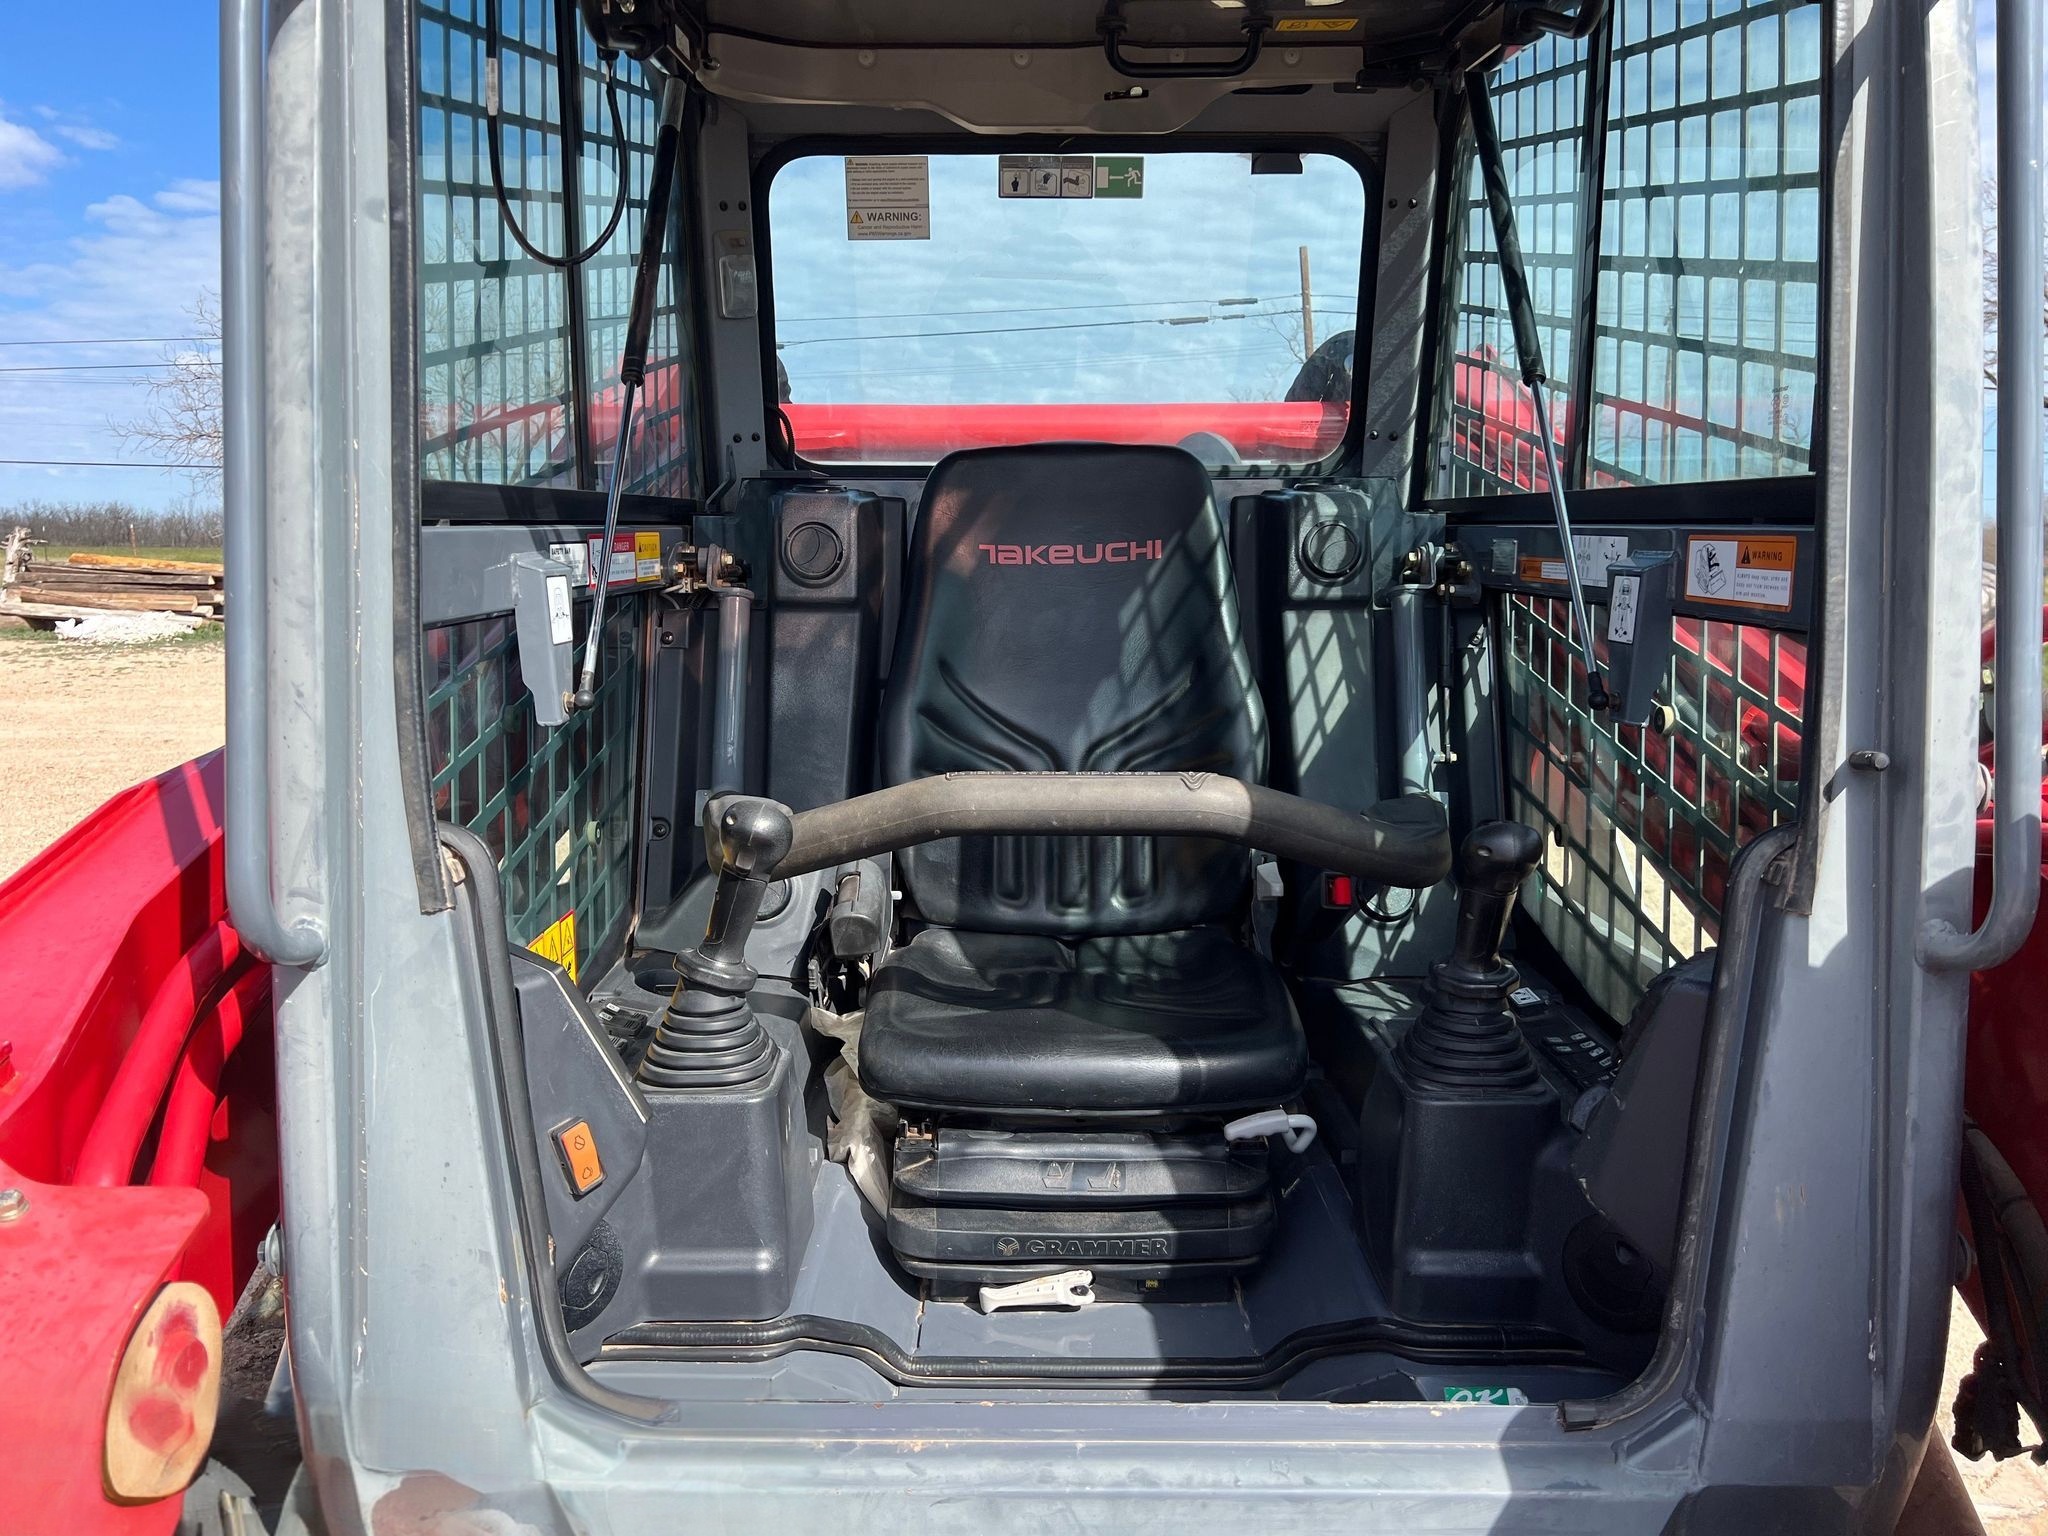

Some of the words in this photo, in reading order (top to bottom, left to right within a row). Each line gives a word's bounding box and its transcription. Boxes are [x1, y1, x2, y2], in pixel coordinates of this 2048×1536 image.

[867, 212, 922, 222] WARNING:
[979, 540, 1162, 565] TAKEUCHI
[1752, 551, 1782, 561] WARNING
[1026, 1238, 1169, 1256] GRAMMER
